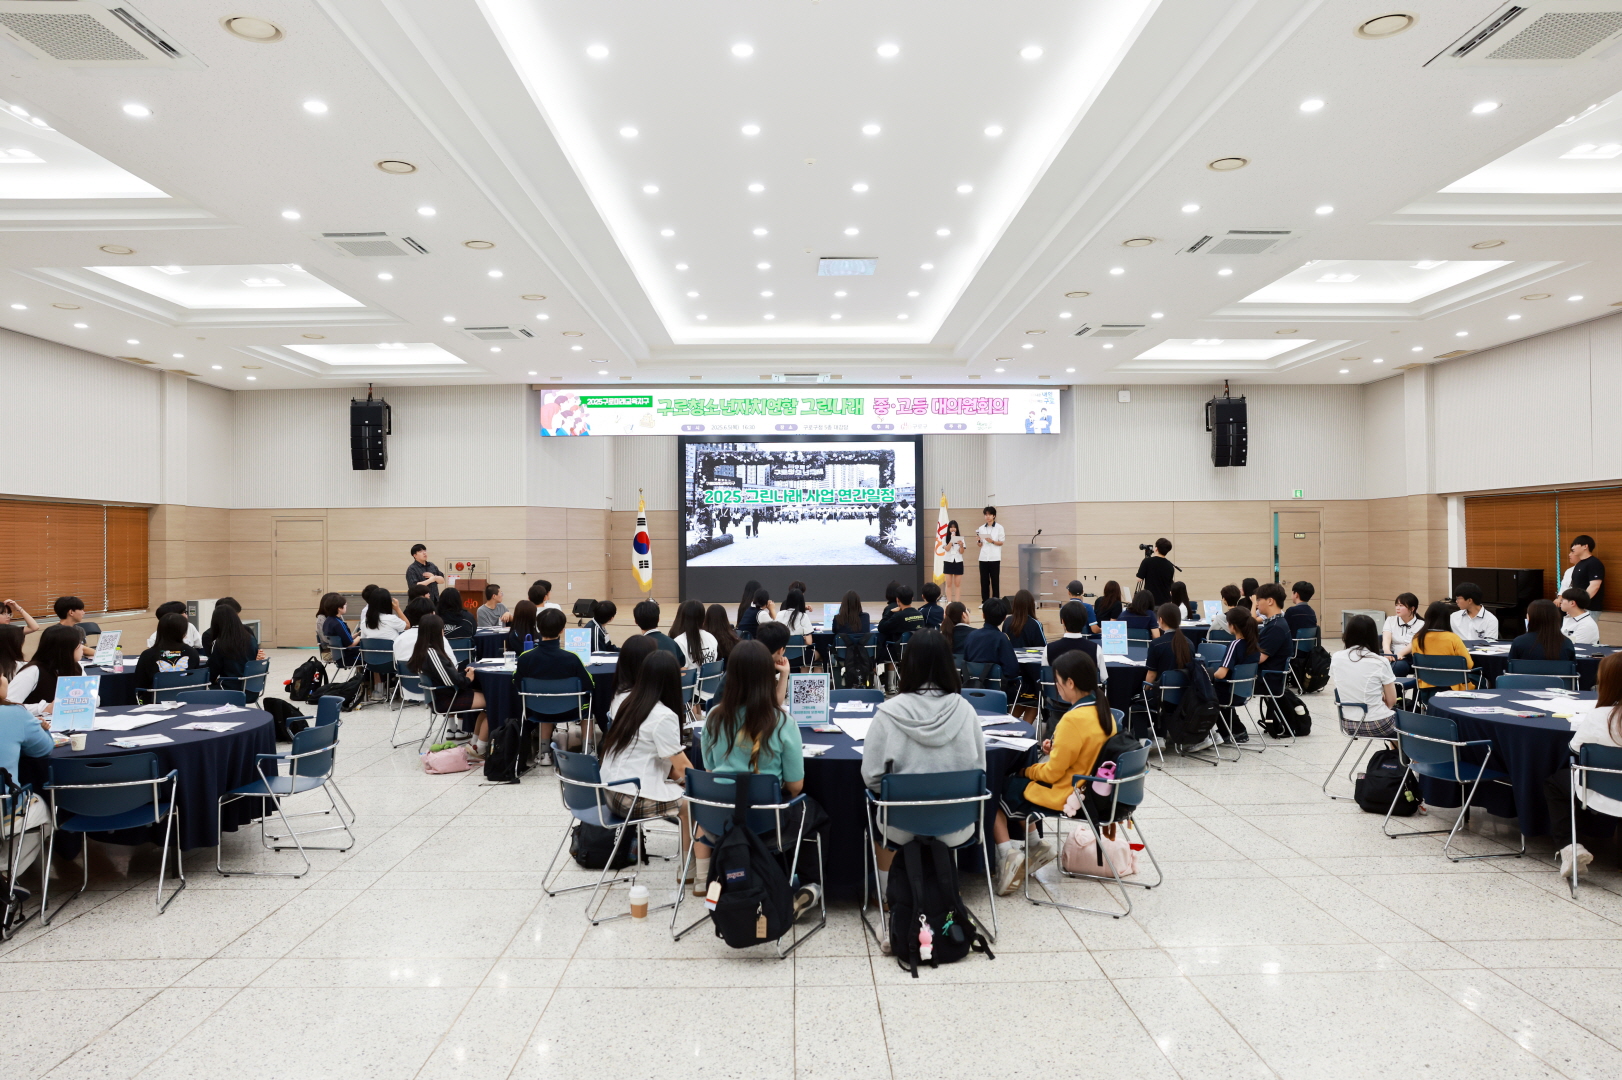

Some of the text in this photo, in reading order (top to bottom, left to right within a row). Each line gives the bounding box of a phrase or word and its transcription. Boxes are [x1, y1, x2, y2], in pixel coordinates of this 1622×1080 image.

[657, 397, 799, 416] 구로청소년자치연합
[800, 398, 864, 416] 그린나래
[931, 397, 1009, 415] 대의원회의
[704, 488, 895, 503] 2025 그린나래 사업 연간일정
[62, 697, 88, 705] 그린나래
